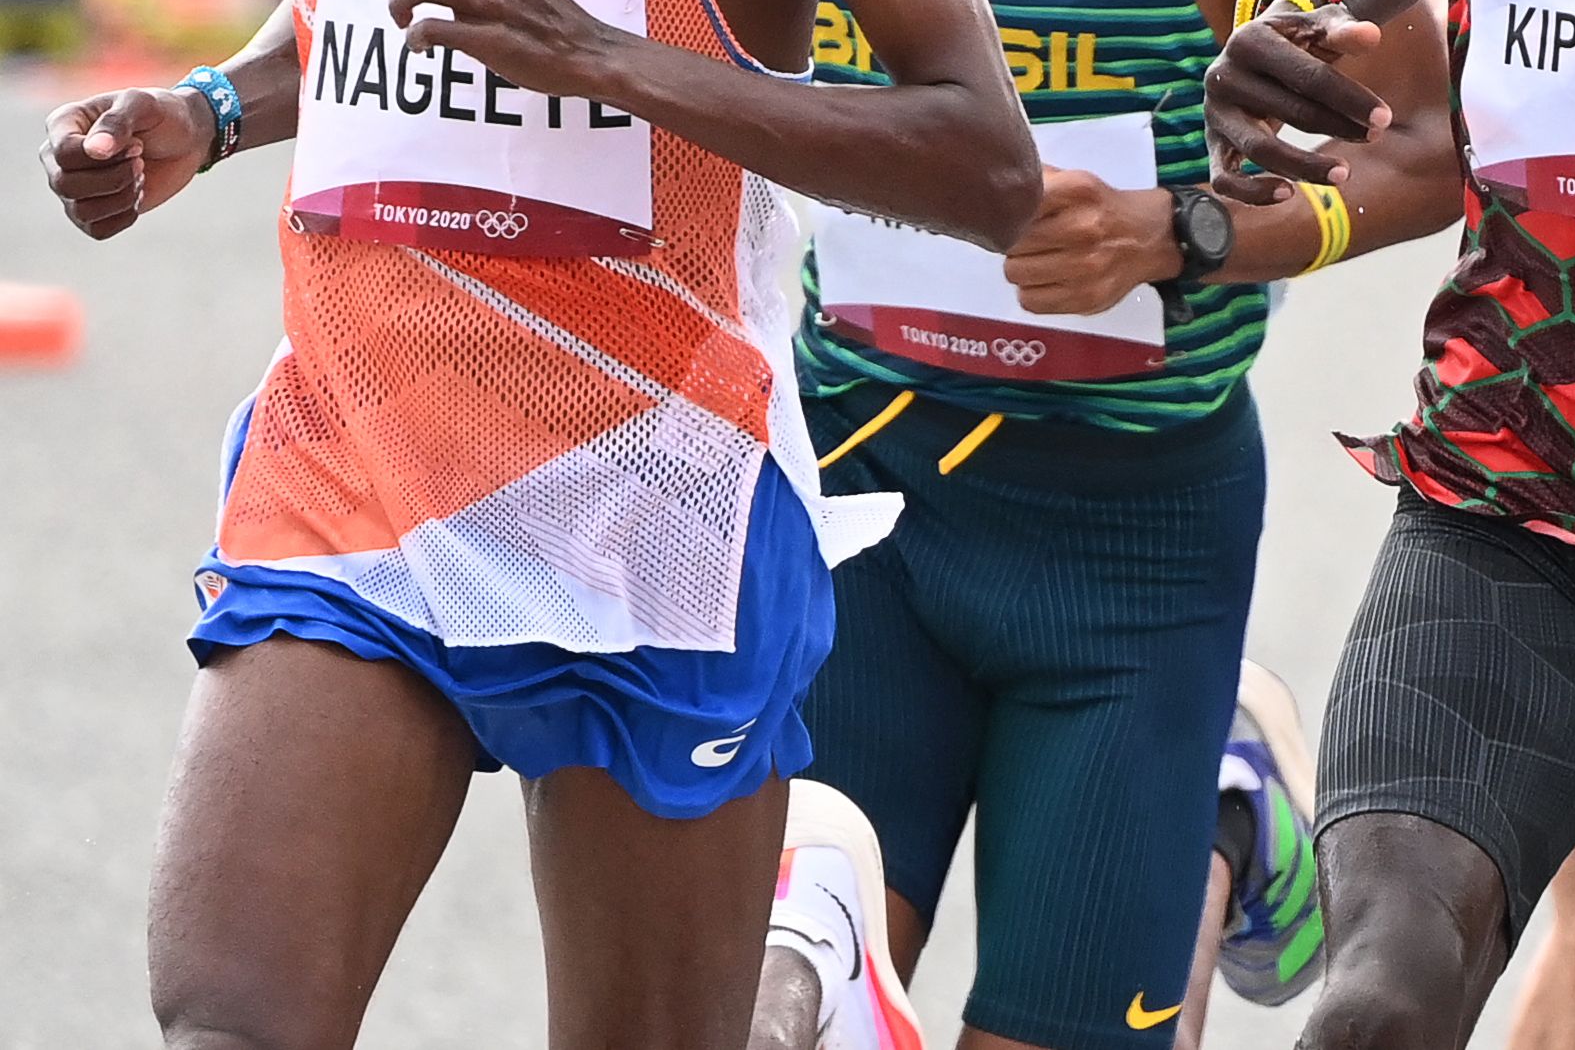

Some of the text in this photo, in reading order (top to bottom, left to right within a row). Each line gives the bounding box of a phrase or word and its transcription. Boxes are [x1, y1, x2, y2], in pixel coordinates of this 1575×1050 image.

[812, 2, 1136, 93] BSIL
[373, 203, 471, 230] TOKYO 2020
[900, 325, 989, 356] TOKYO 2020
